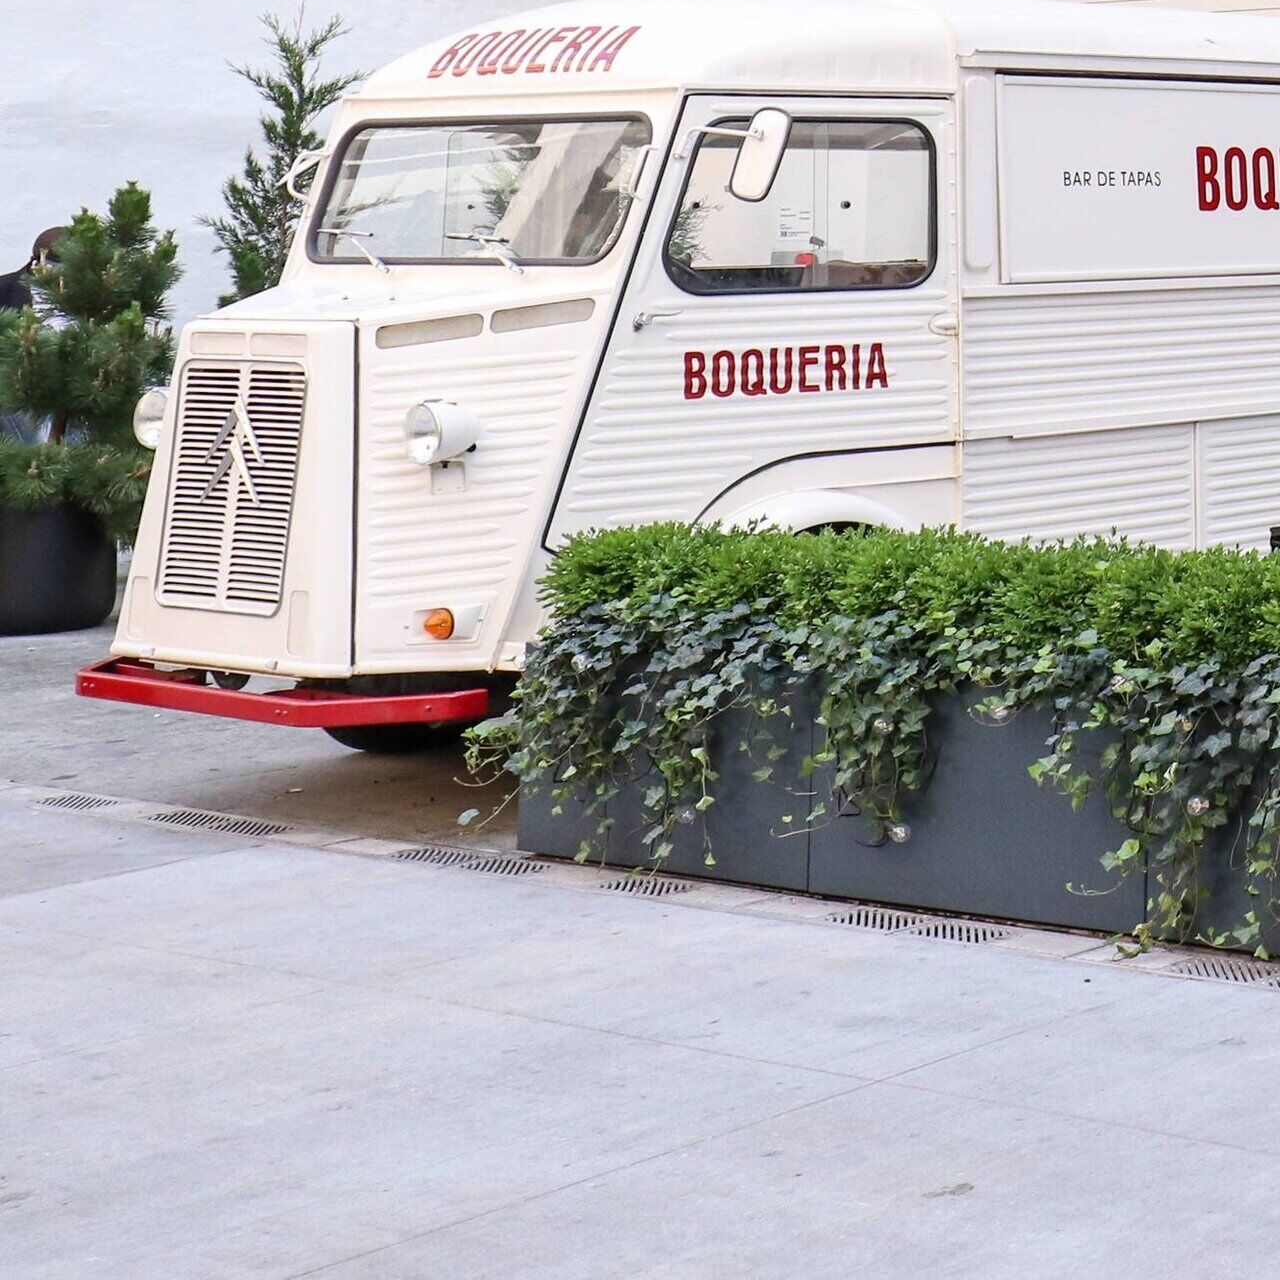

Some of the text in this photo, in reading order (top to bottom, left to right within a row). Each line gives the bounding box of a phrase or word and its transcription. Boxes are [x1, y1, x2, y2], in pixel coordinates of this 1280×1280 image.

[427, 25, 642, 79] BOQUERIA
[1063, 171, 1162, 187] BAR DE TAPAS
[683, 342, 889, 400] BOQUERIA
